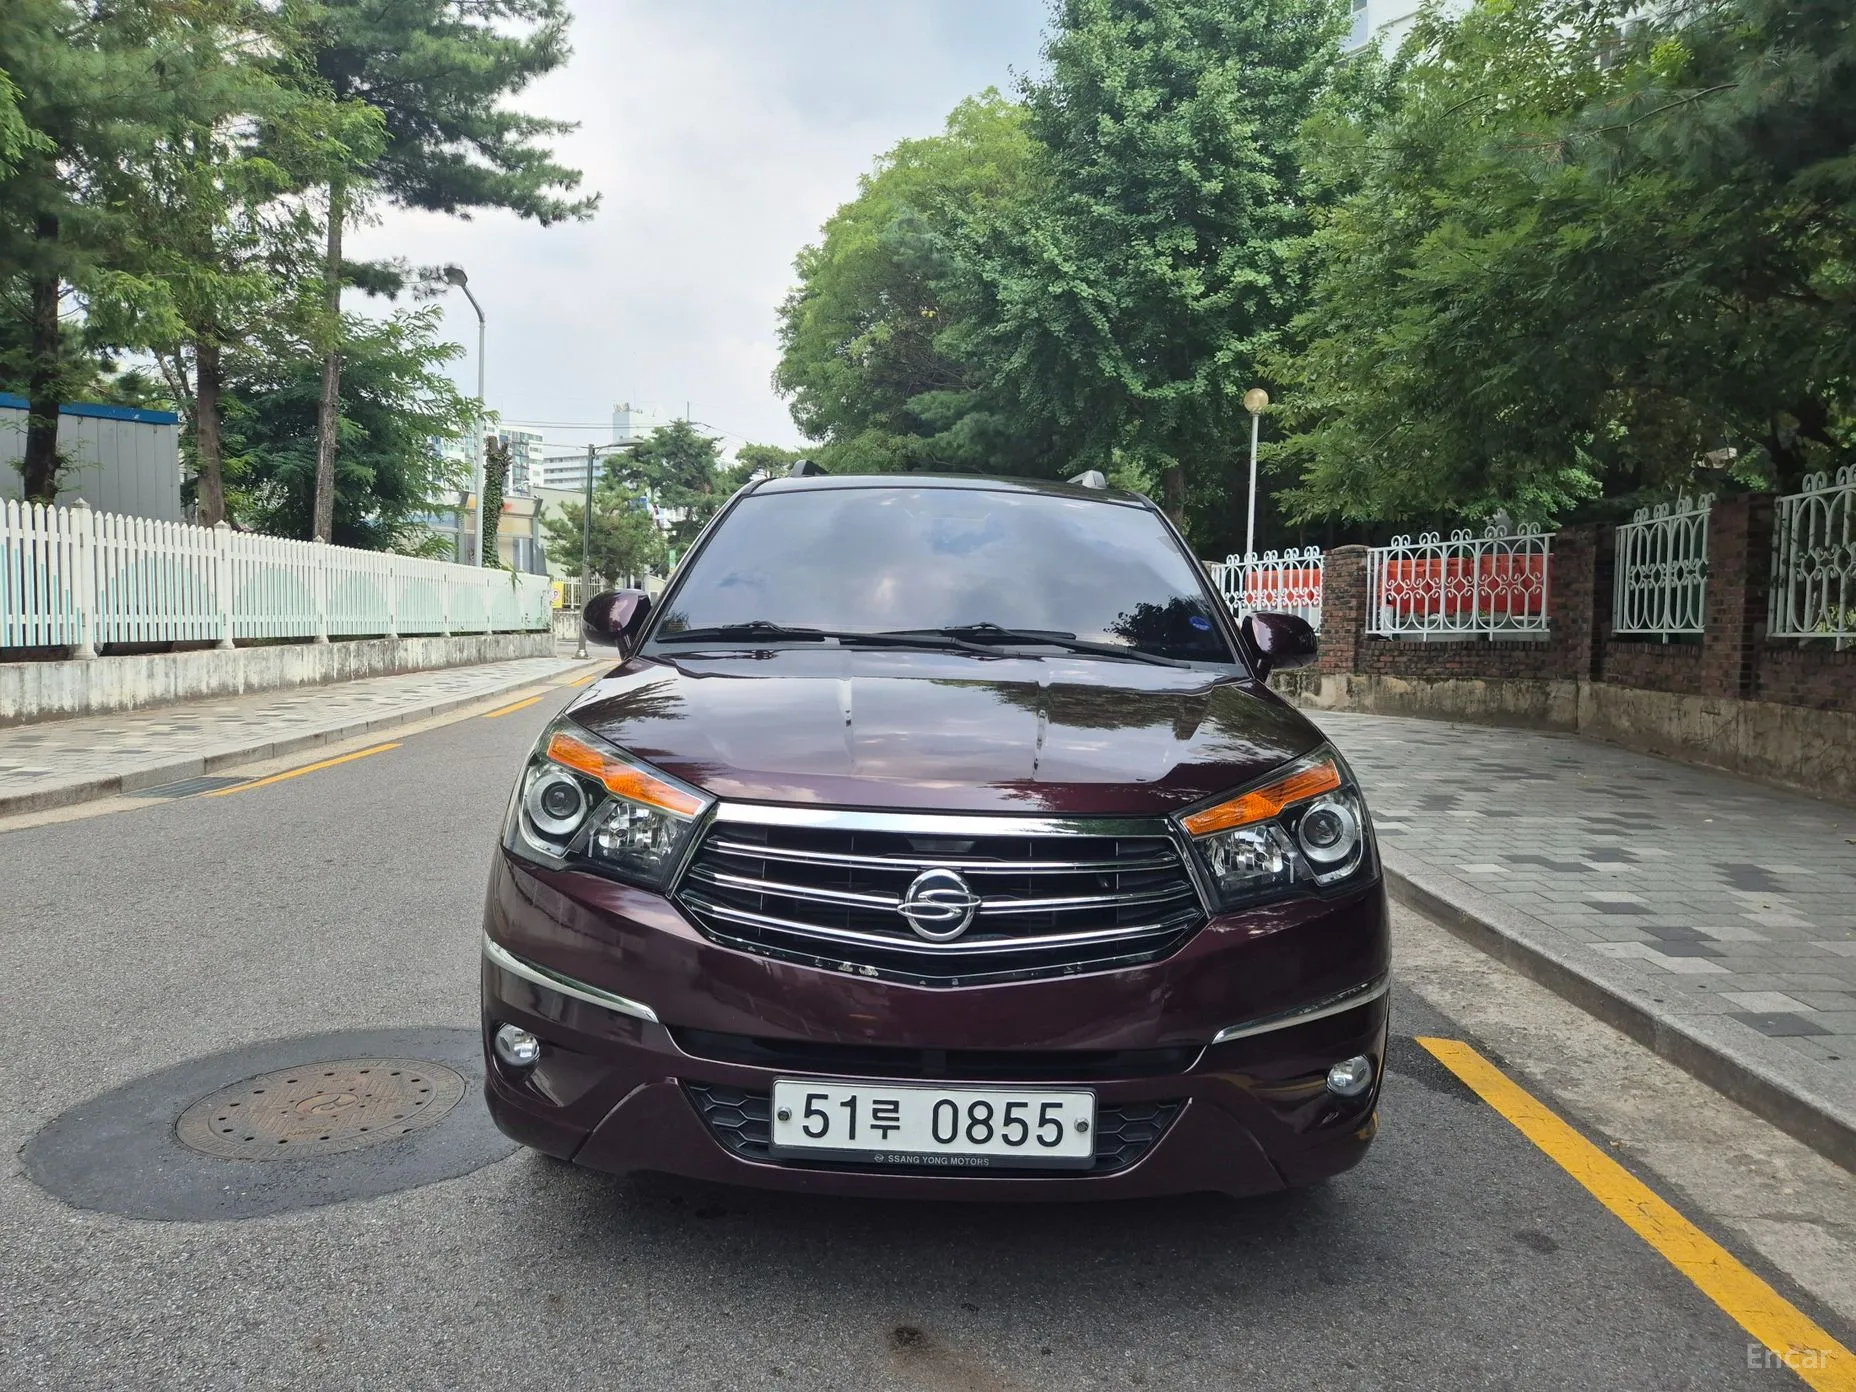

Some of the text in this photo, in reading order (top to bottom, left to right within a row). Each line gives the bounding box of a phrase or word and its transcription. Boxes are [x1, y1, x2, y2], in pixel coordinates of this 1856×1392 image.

[802, 1093, 1064, 1148] 51루 0855
[888, 1154, 990, 1166] SSANG YONG MOTORS
